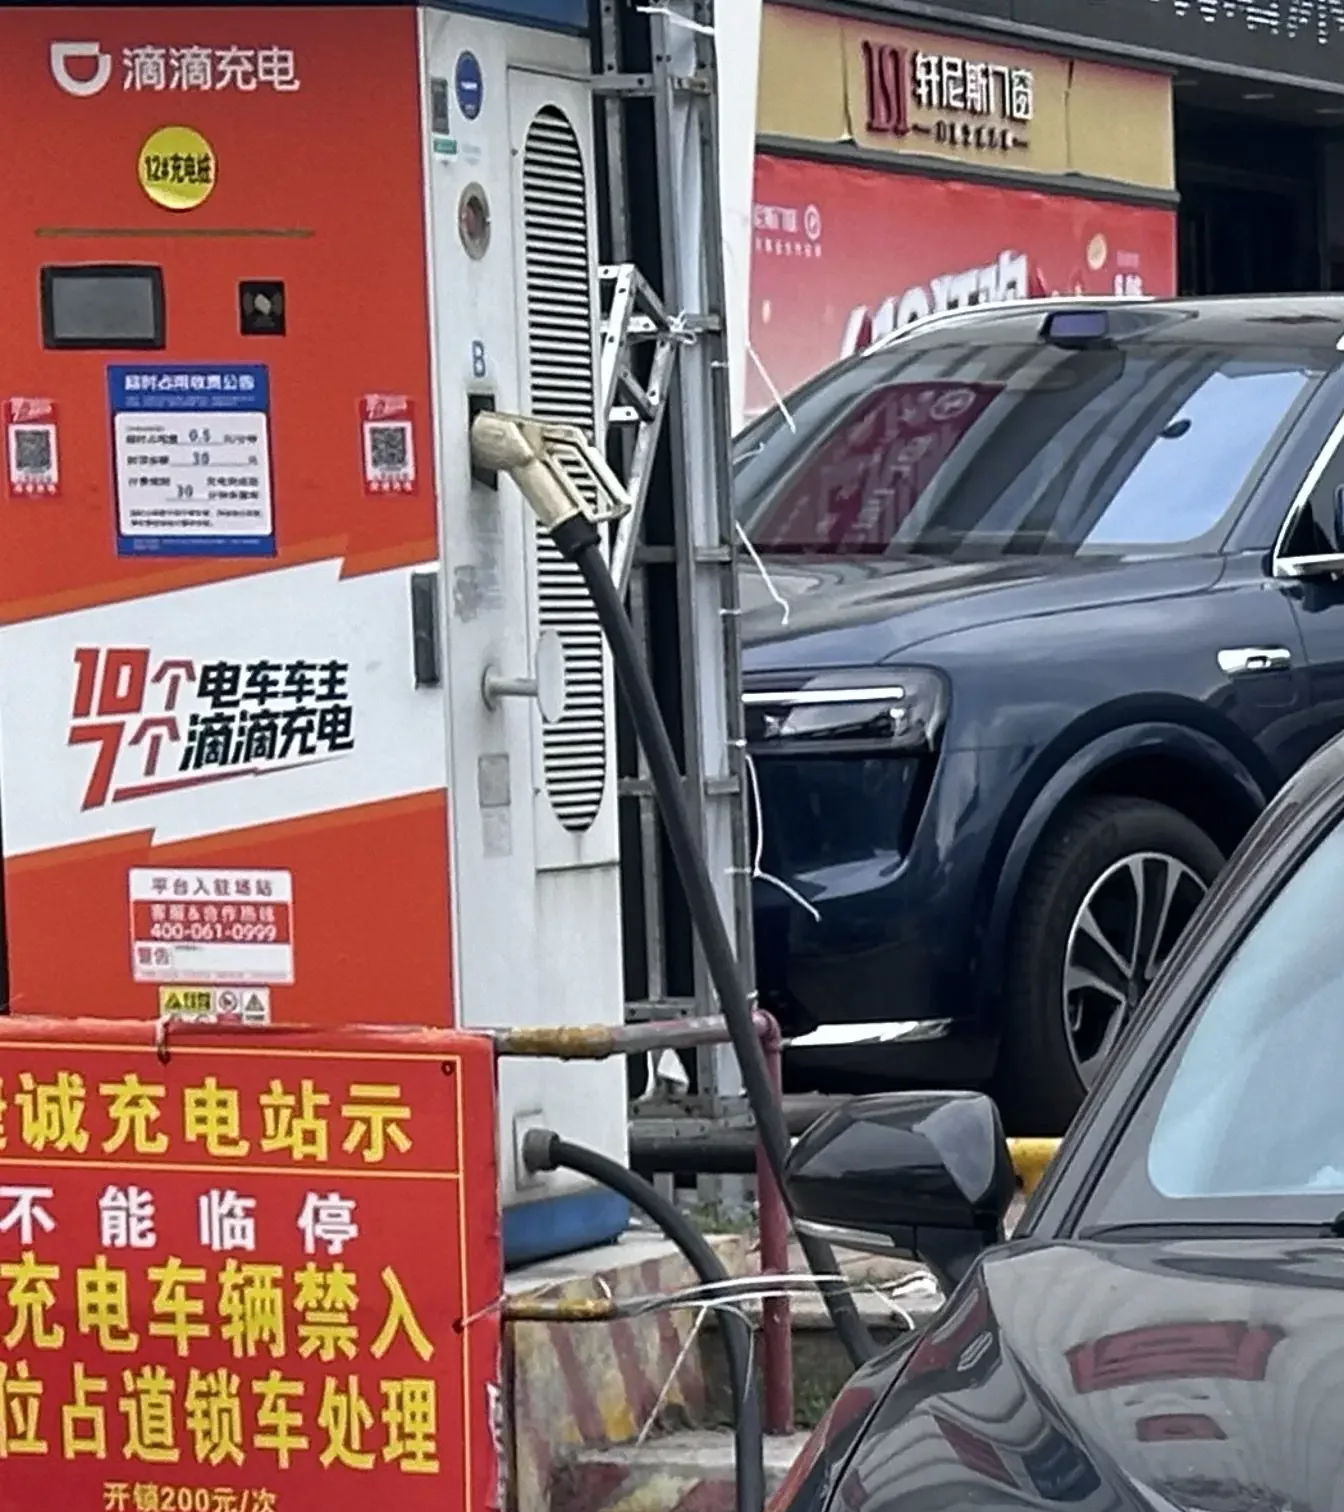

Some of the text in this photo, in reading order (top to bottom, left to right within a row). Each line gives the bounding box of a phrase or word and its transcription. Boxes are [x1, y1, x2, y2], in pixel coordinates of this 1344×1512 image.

[122, 46, 300, 91] 滴滴充电
[915, 52, 1034, 121] 轩尼斯门窗
[471, 340, 485, 377] B
[72, 646, 351, 719] 10个电车车主
[67, 704, 356, 812] 7个滴滴充电
[152, 877, 273, 896] 平台入驻场站
[150, 922, 277, 941] 400-061-0999
[0, 1071, 413, 1164] 诚充电站示
[0, 1250, 436, 1363] 充电车辆禁入
[0, 1359, 441, 1475] 位占道锁车处理
